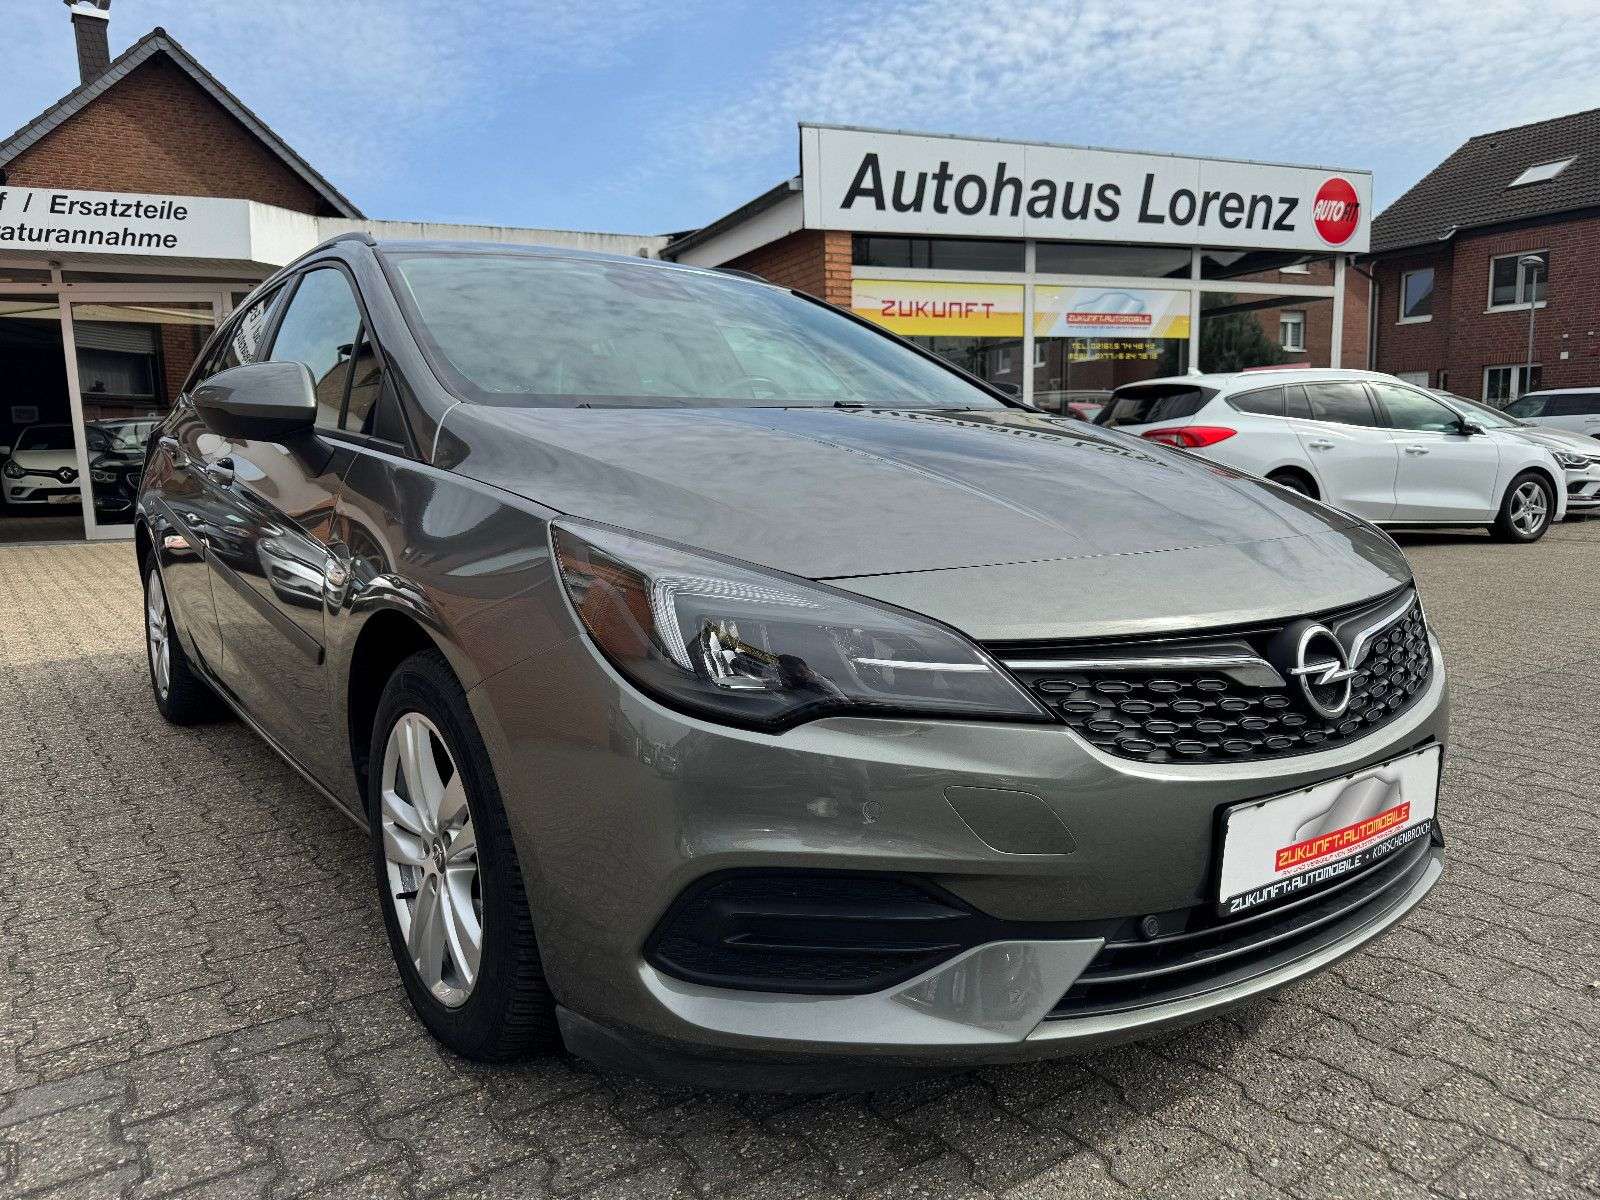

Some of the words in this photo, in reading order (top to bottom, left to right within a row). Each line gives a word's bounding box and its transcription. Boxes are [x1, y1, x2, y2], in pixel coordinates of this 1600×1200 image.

[840, 152, 1122, 223] Autohaus
[1138, 173, 1300, 232] Lorenz
[50, 194, 188, 221] Ersatzteile
[0, 223, 178, 249] aturannahme
[881, 300, 994, 319] ZUKUNFT
